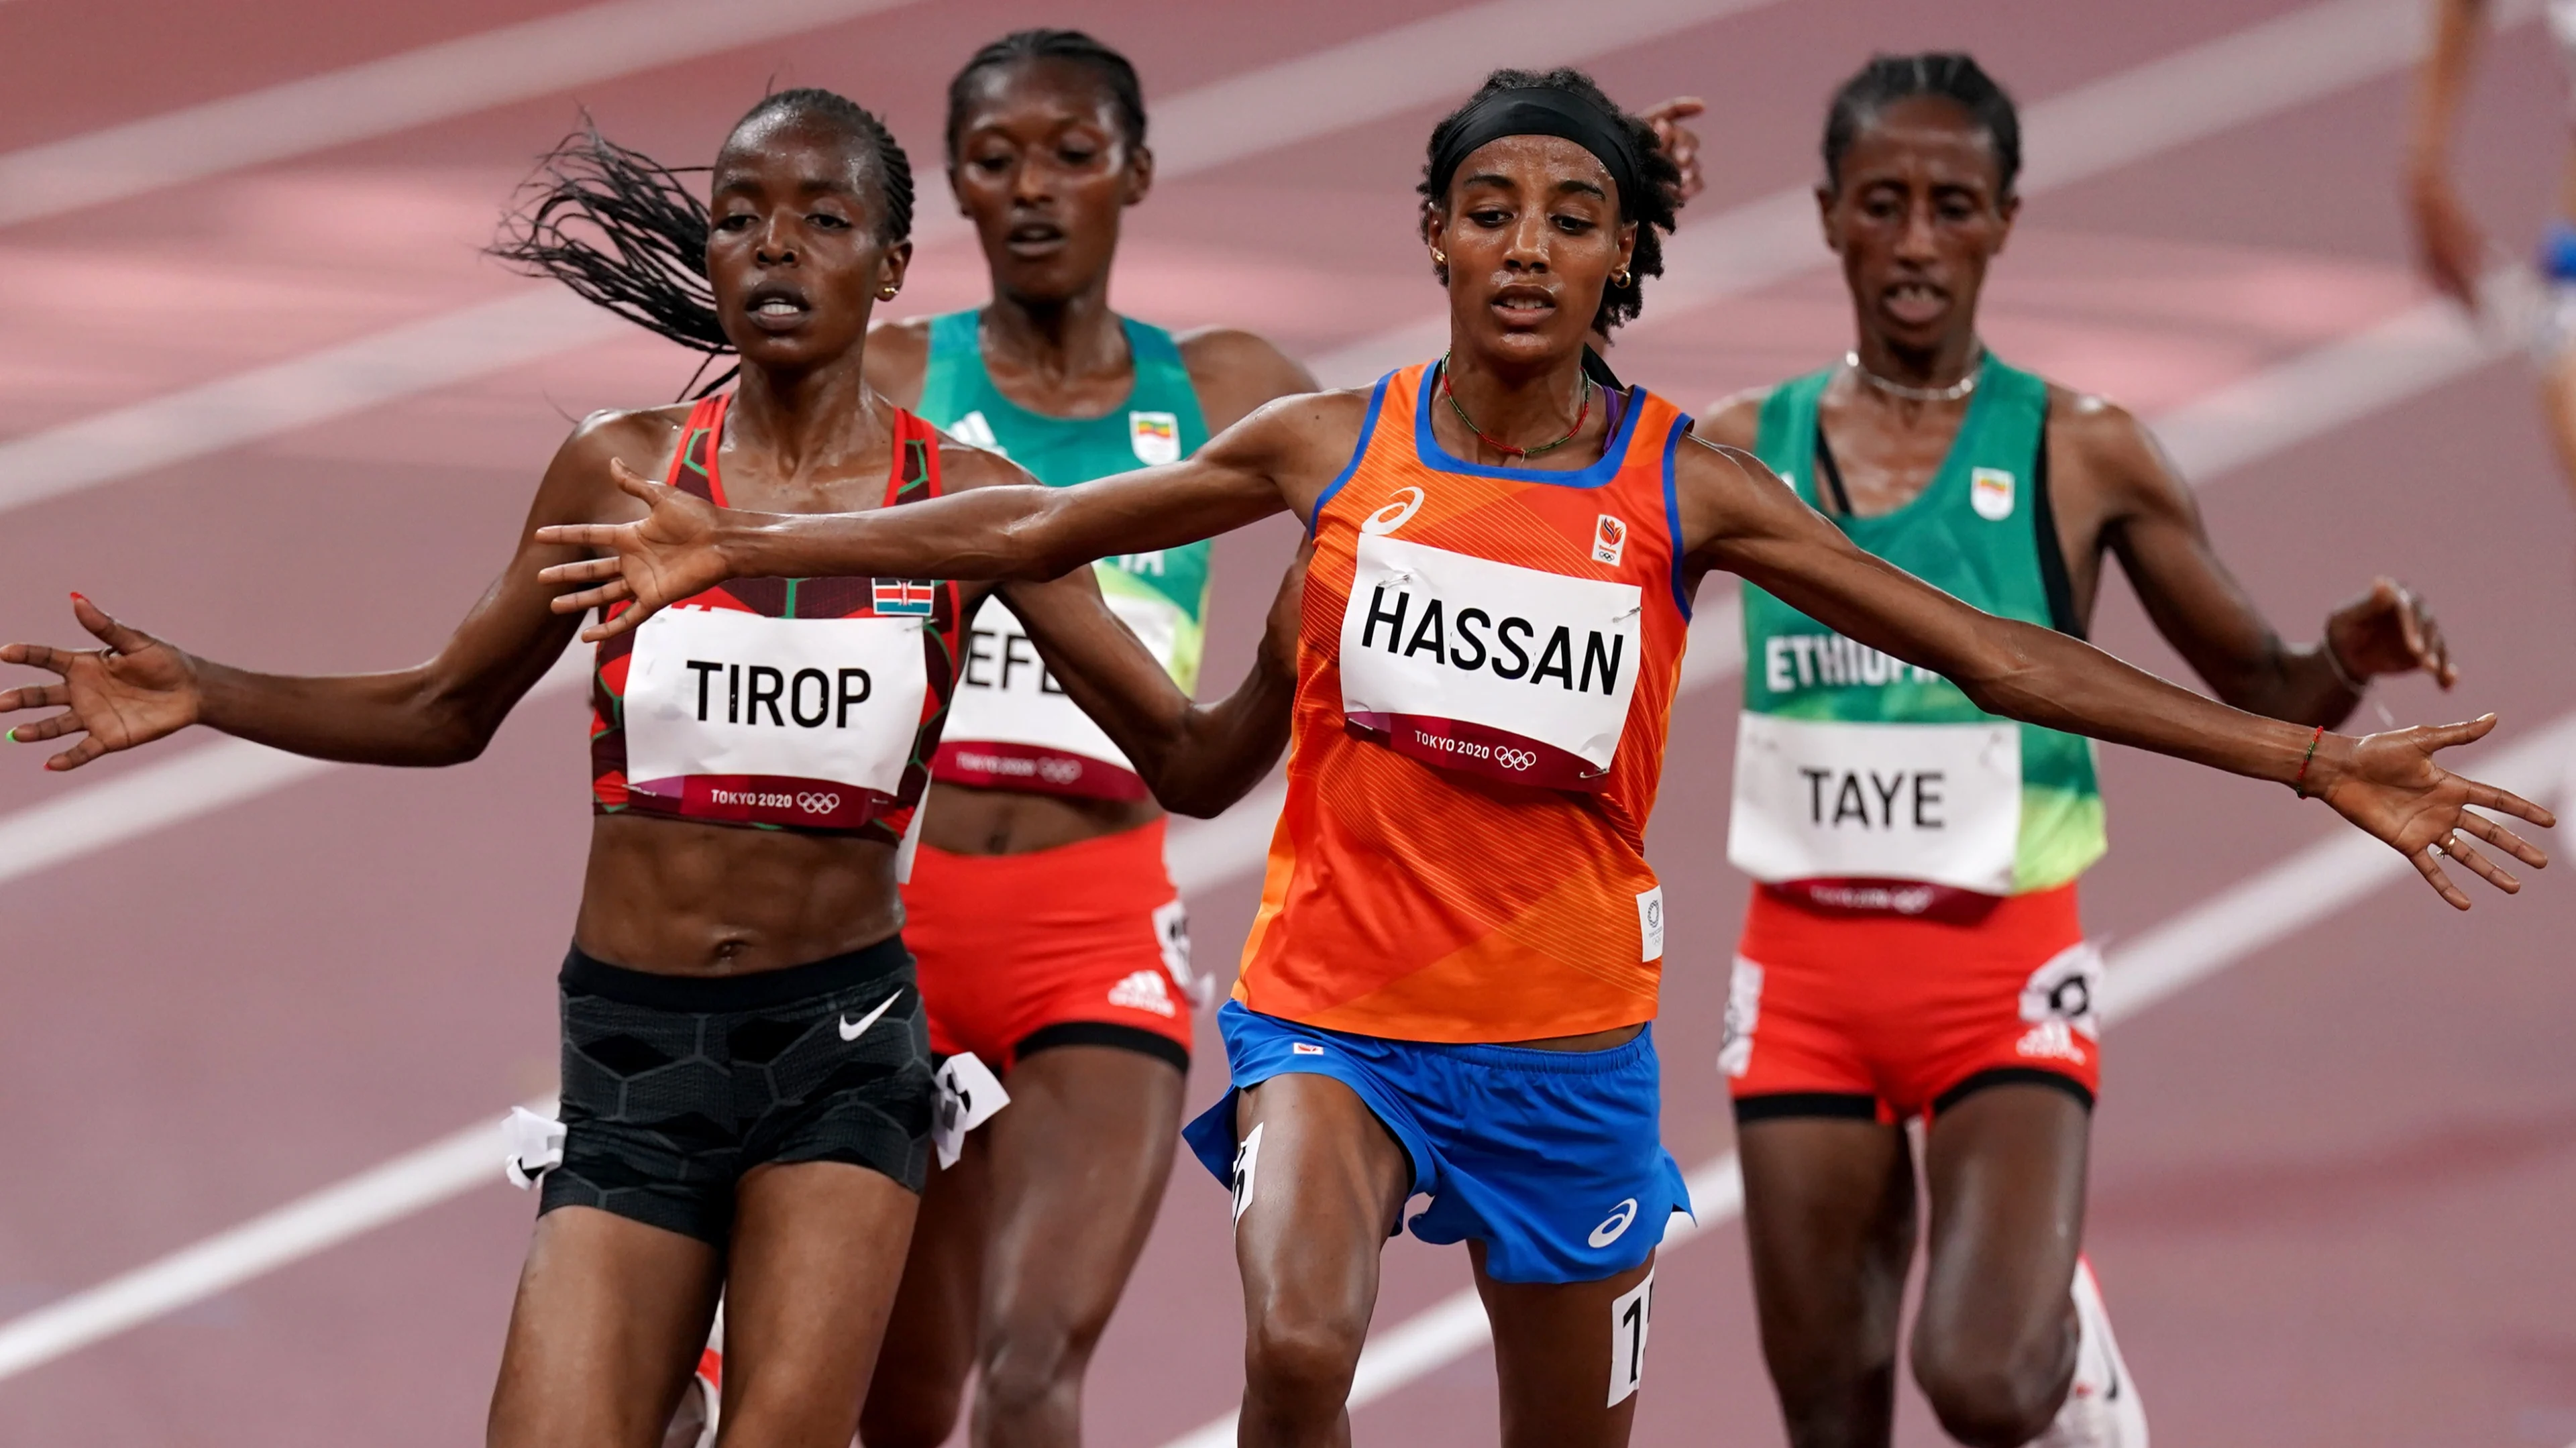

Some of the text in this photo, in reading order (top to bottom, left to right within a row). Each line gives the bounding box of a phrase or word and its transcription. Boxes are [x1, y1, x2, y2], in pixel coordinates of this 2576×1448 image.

[1362, 586, 1624, 696] HASSAN
[1765, 632, 1939, 693] ETHIO
[686, 660, 871, 728] TIROP
[1415, 730, 1490, 759] TOKYO 2020
[711, 789, 792, 808] TOKYO 2020
[1802, 769, 1943, 830] TAYE
